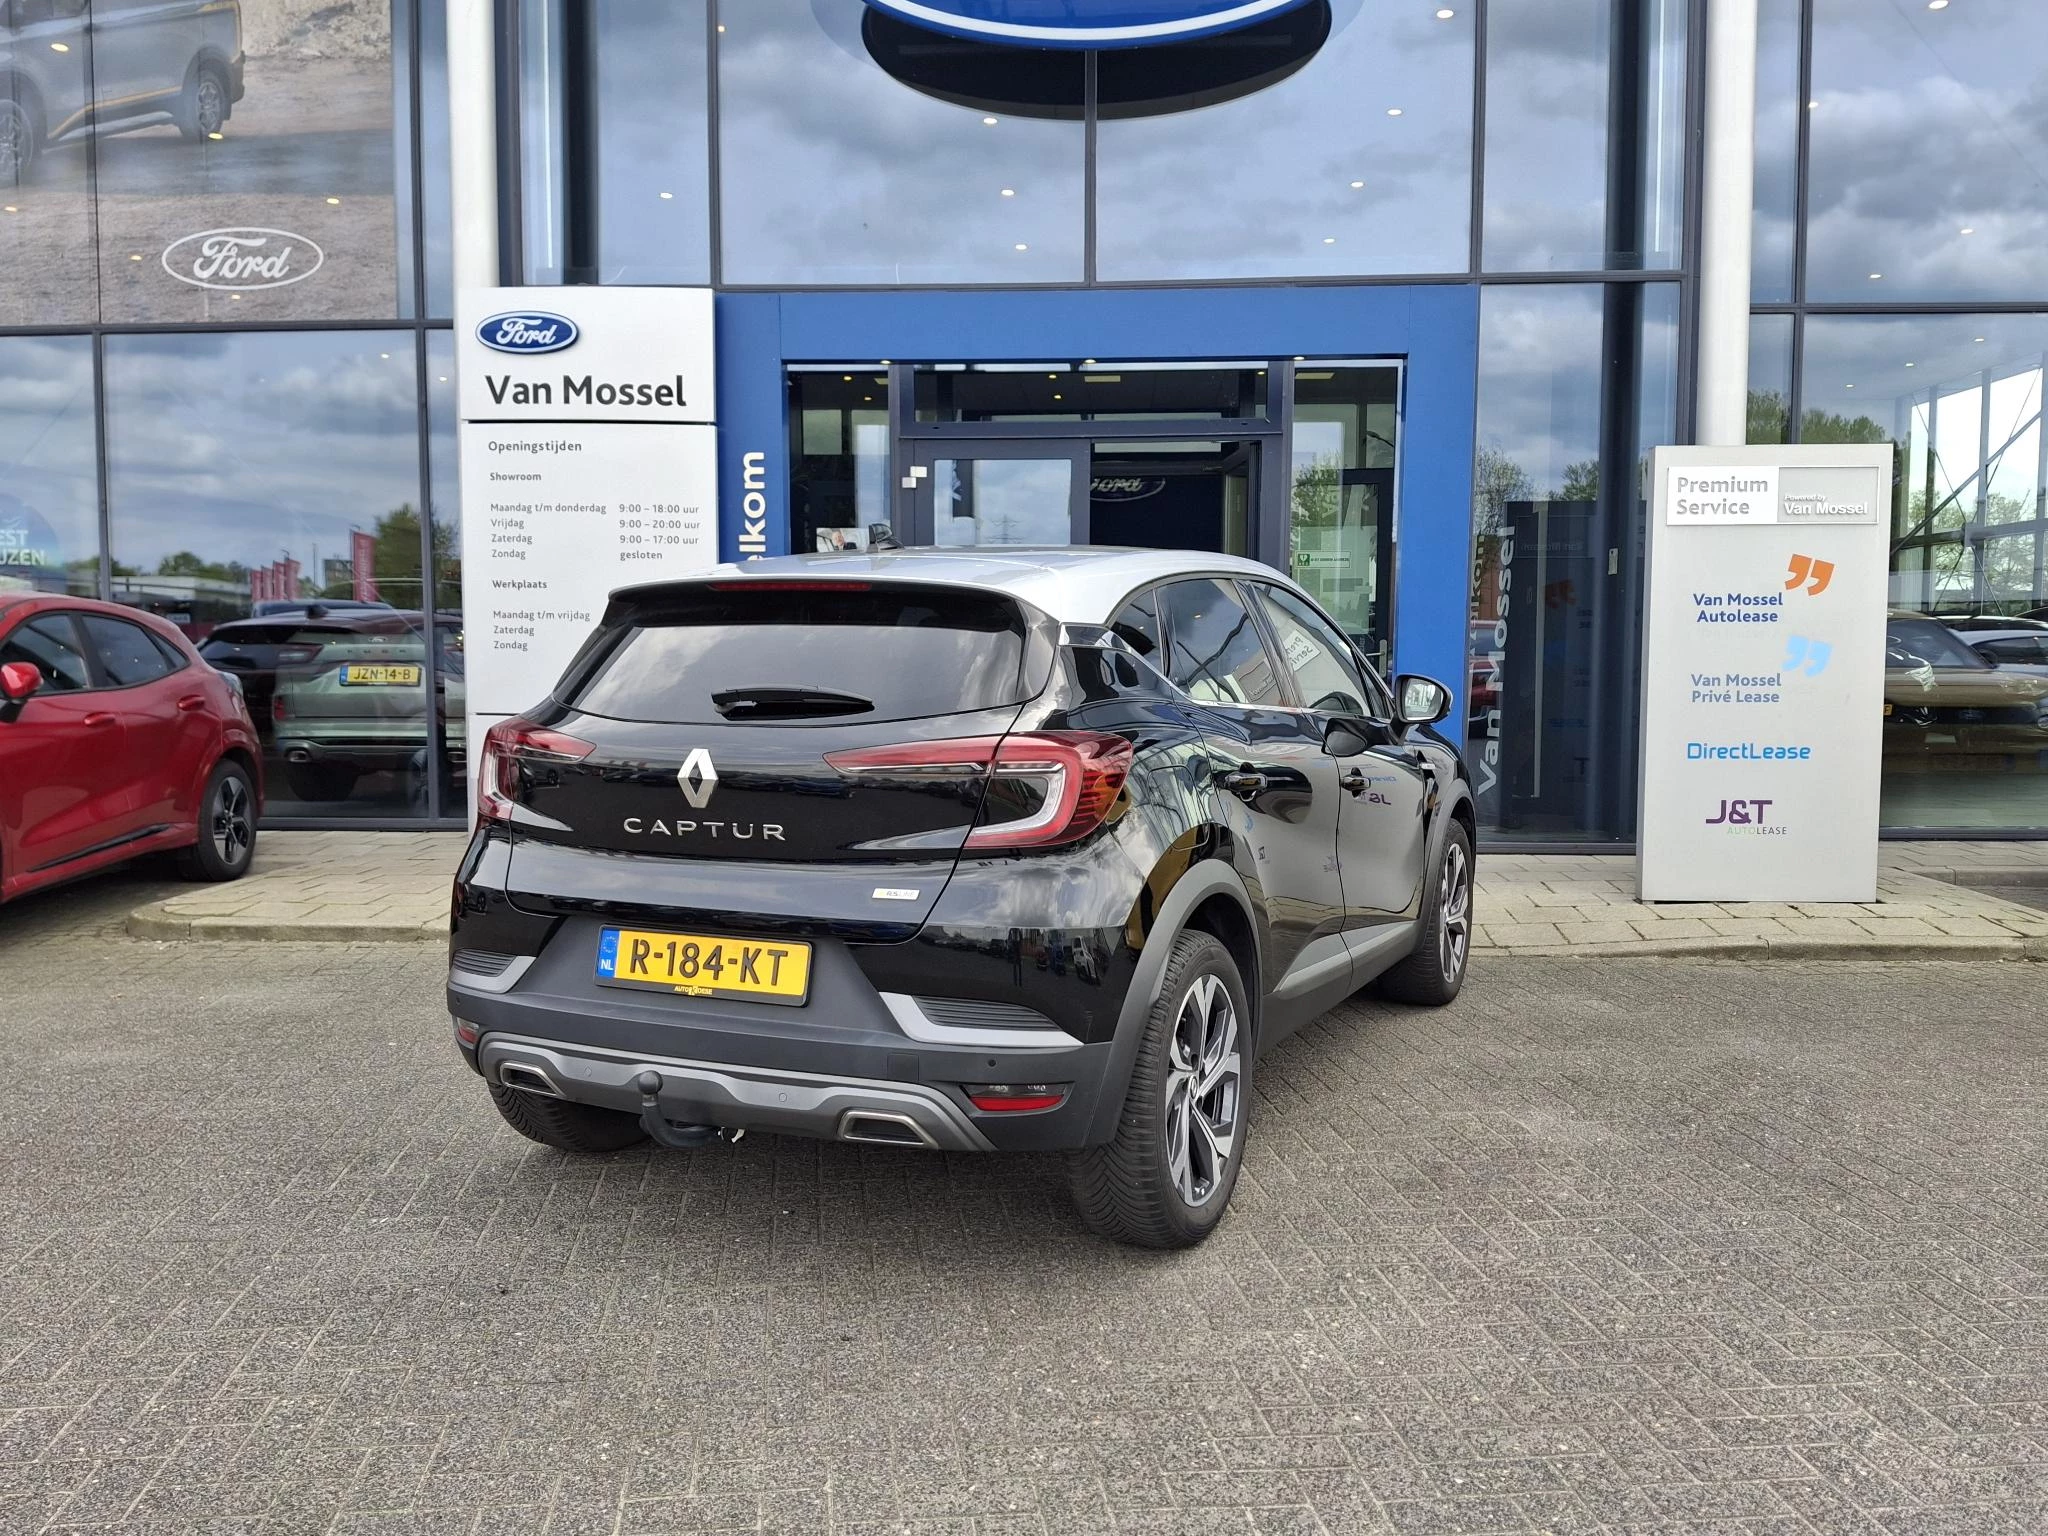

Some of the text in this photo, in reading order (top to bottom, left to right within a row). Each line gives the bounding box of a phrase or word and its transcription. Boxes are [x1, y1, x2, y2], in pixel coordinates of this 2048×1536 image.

[193, 236, 293, 279] Ford
[496, 317, 556, 345] Ford
[484, 375, 687, 407] Van Mossel
[488, 440, 582, 454] Openingstijden
[490, 472, 542, 482] Showroom
[1677, 476, 1768, 493] Premium
[490, 503, 533, 514] Maandag
[535, 503, 552, 513] t/m
[555, 503, 606, 515] donderdag
[619, 504, 641, 513] 9:00
[653, 504, 680, 513] 18:00
[1677, 498, 1750, 515] Service
[1785, 502, 1868, 514] Van Mossel
[490, 518, 524, 530] Vrijdag
[619, 520, 641, 529] 9:00
[652, 520, 681, 529] 20:00
[491, 534, 533, 545] Zaterdag
[619, 535, 641, 544] 9:00
[653, 535, 680, 544] 17:00
[491, 549, 662, 561] Zondag gesloten
[492, 579, 548, 592] Werkplaats
[1693, 592, 1783, 606] Van Mossel
[493, 610, 591, 622] Maandag t/m vrijdag
[1697, 609, 1779, 623] Autolease
[494, 625, 535, 637] Zaterdag
[493, 640, 528, 652] Zondag
[1477, 524, 1516, 796] Van Mossel
[354, 668, 411, 680] JZN-14-B
[1691, 673, 1782, 686] Van Mossel
[1692, 690, 1780, 703] Privé Lease
[1687, 743, 1811, 759] DirectLease
[1706, 799, 1773, 824] J&T
[623, 817, 786, 841] CAPTUR
[1727, 826, 1788, 835] AUTOLEASE
[600, 959, 614, 971] NL
[630, 938, 789, 986] R-184-KT
